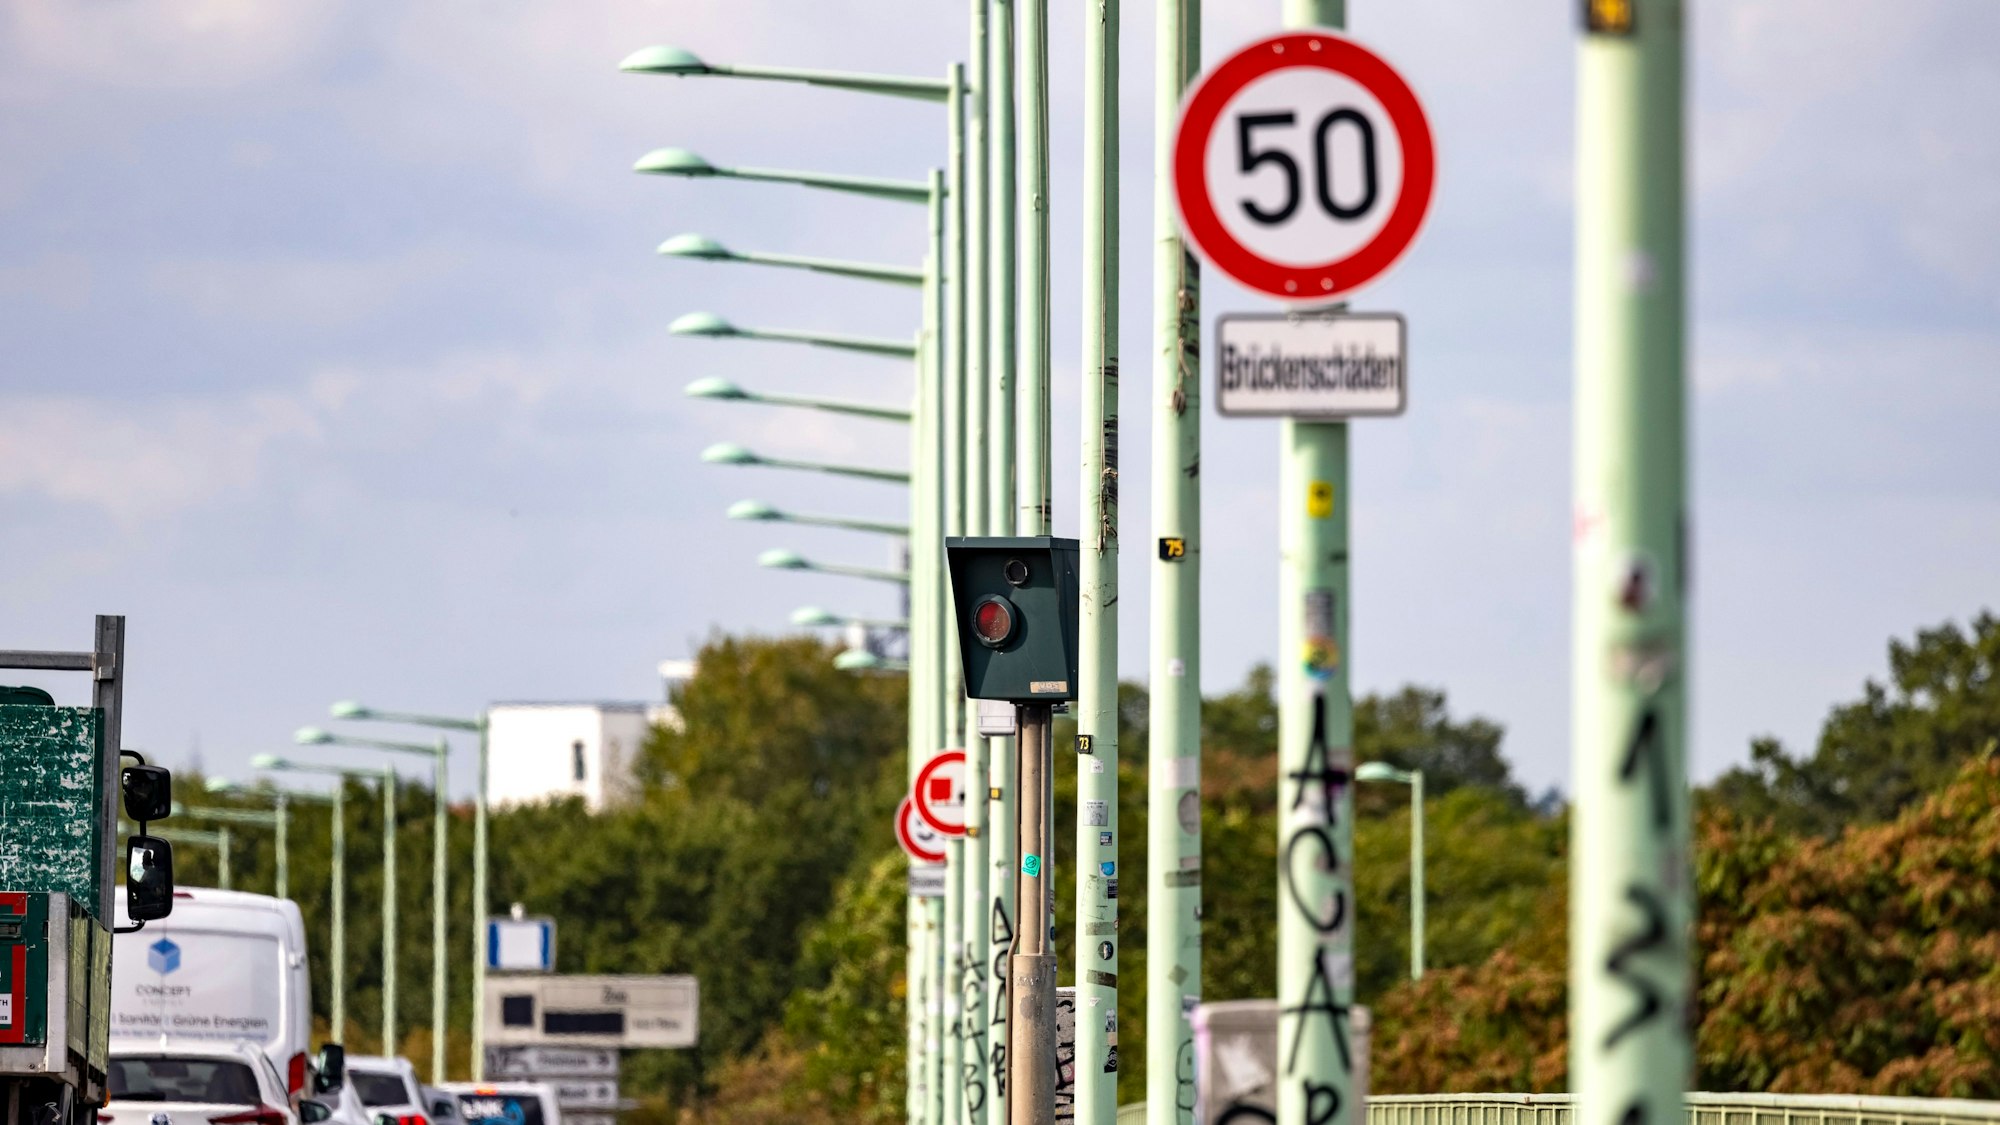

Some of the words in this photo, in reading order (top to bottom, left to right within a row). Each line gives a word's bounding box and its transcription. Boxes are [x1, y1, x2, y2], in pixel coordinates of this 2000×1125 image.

[1236, 105, 1380, 225] 50
[1222, 342, 1400, 392] Brückenschäden
[1165, 539, 1184, 557] 75
[1078, 737, 1089, 750] 73
[136, 984, 191, 997] CONCEPT
[213, 1013, 268, 1030] Energien
